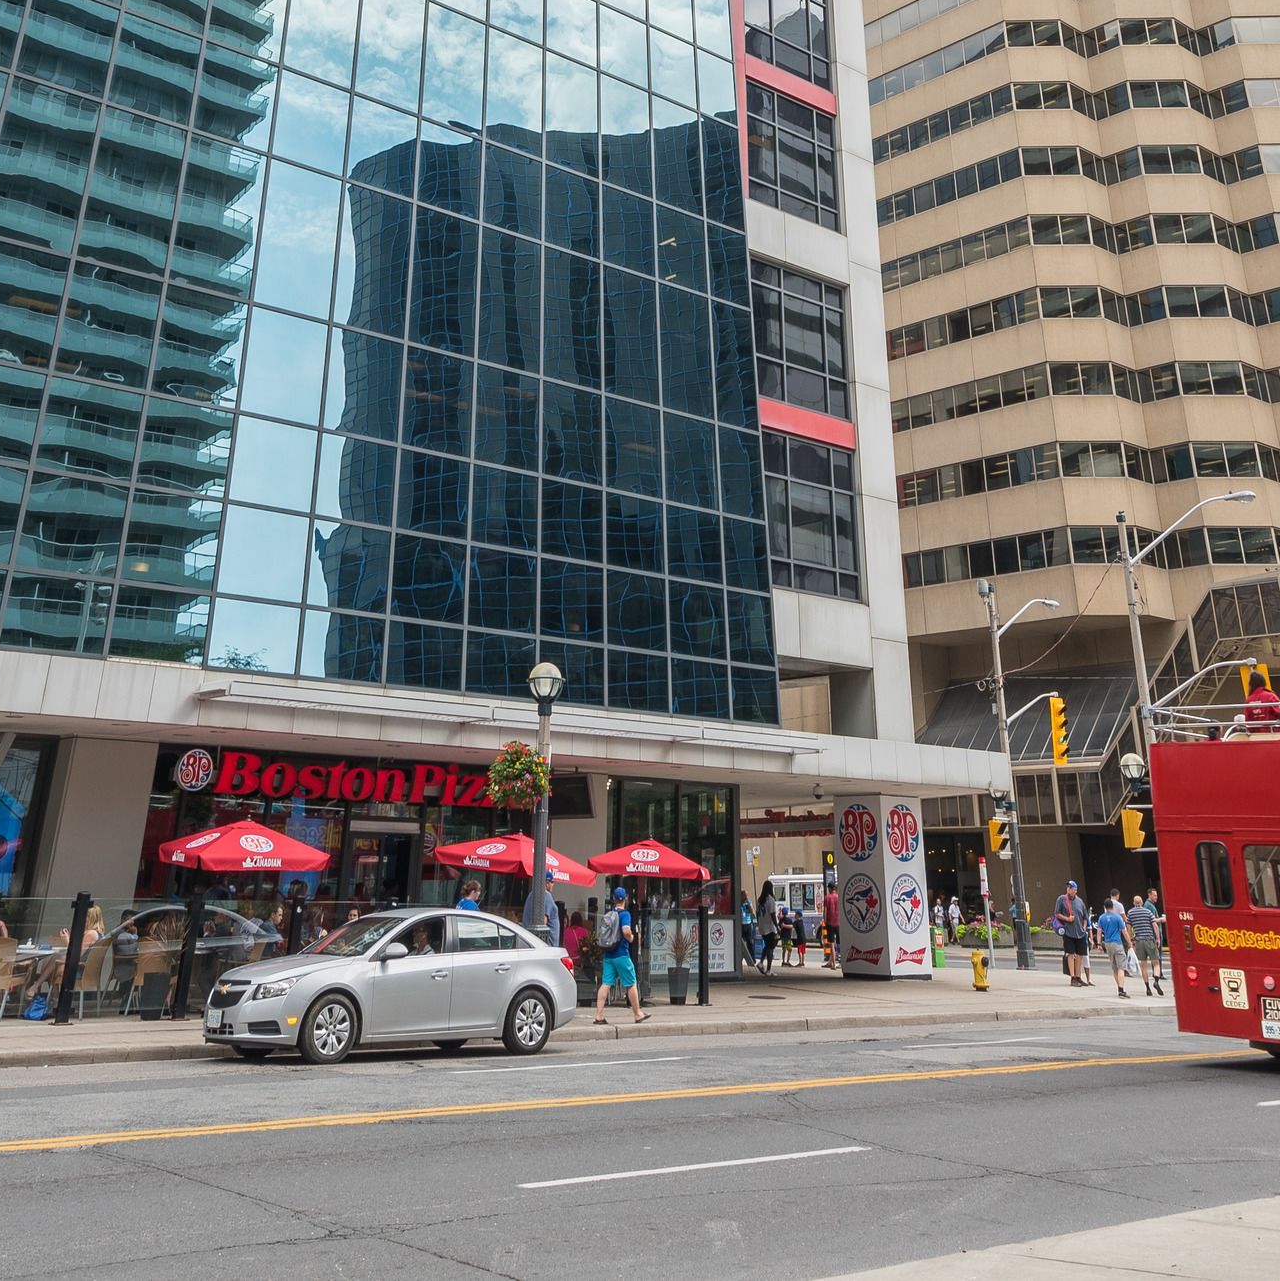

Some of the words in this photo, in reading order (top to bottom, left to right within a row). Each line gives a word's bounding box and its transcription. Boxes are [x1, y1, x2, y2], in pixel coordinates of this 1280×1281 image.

[213, 751, 407, 802] Boston
[841, 809, 877, 856] BP
[888, 808, 918, 856] BP
[252, 858, 282, 867] CANADIAN
[471, 857, 490, 867] CANADIAN
[635, 864, 660, 873] CANADIAN
[846, 877, 871, 896] TORONTO
[893, 877, 914, 896] TORONTO
[846, 909, 862, 929] BLUE
[864, 911, 879, 930] JAYS
[894, 909, 908, 929] BLUE
[910, 910, 922, 929] JAYS
[848, 949, 882, 961] Budweiser
[896, 949, 926, 962] Budweiser
[1222, 970, 1242, 978] YIELD
